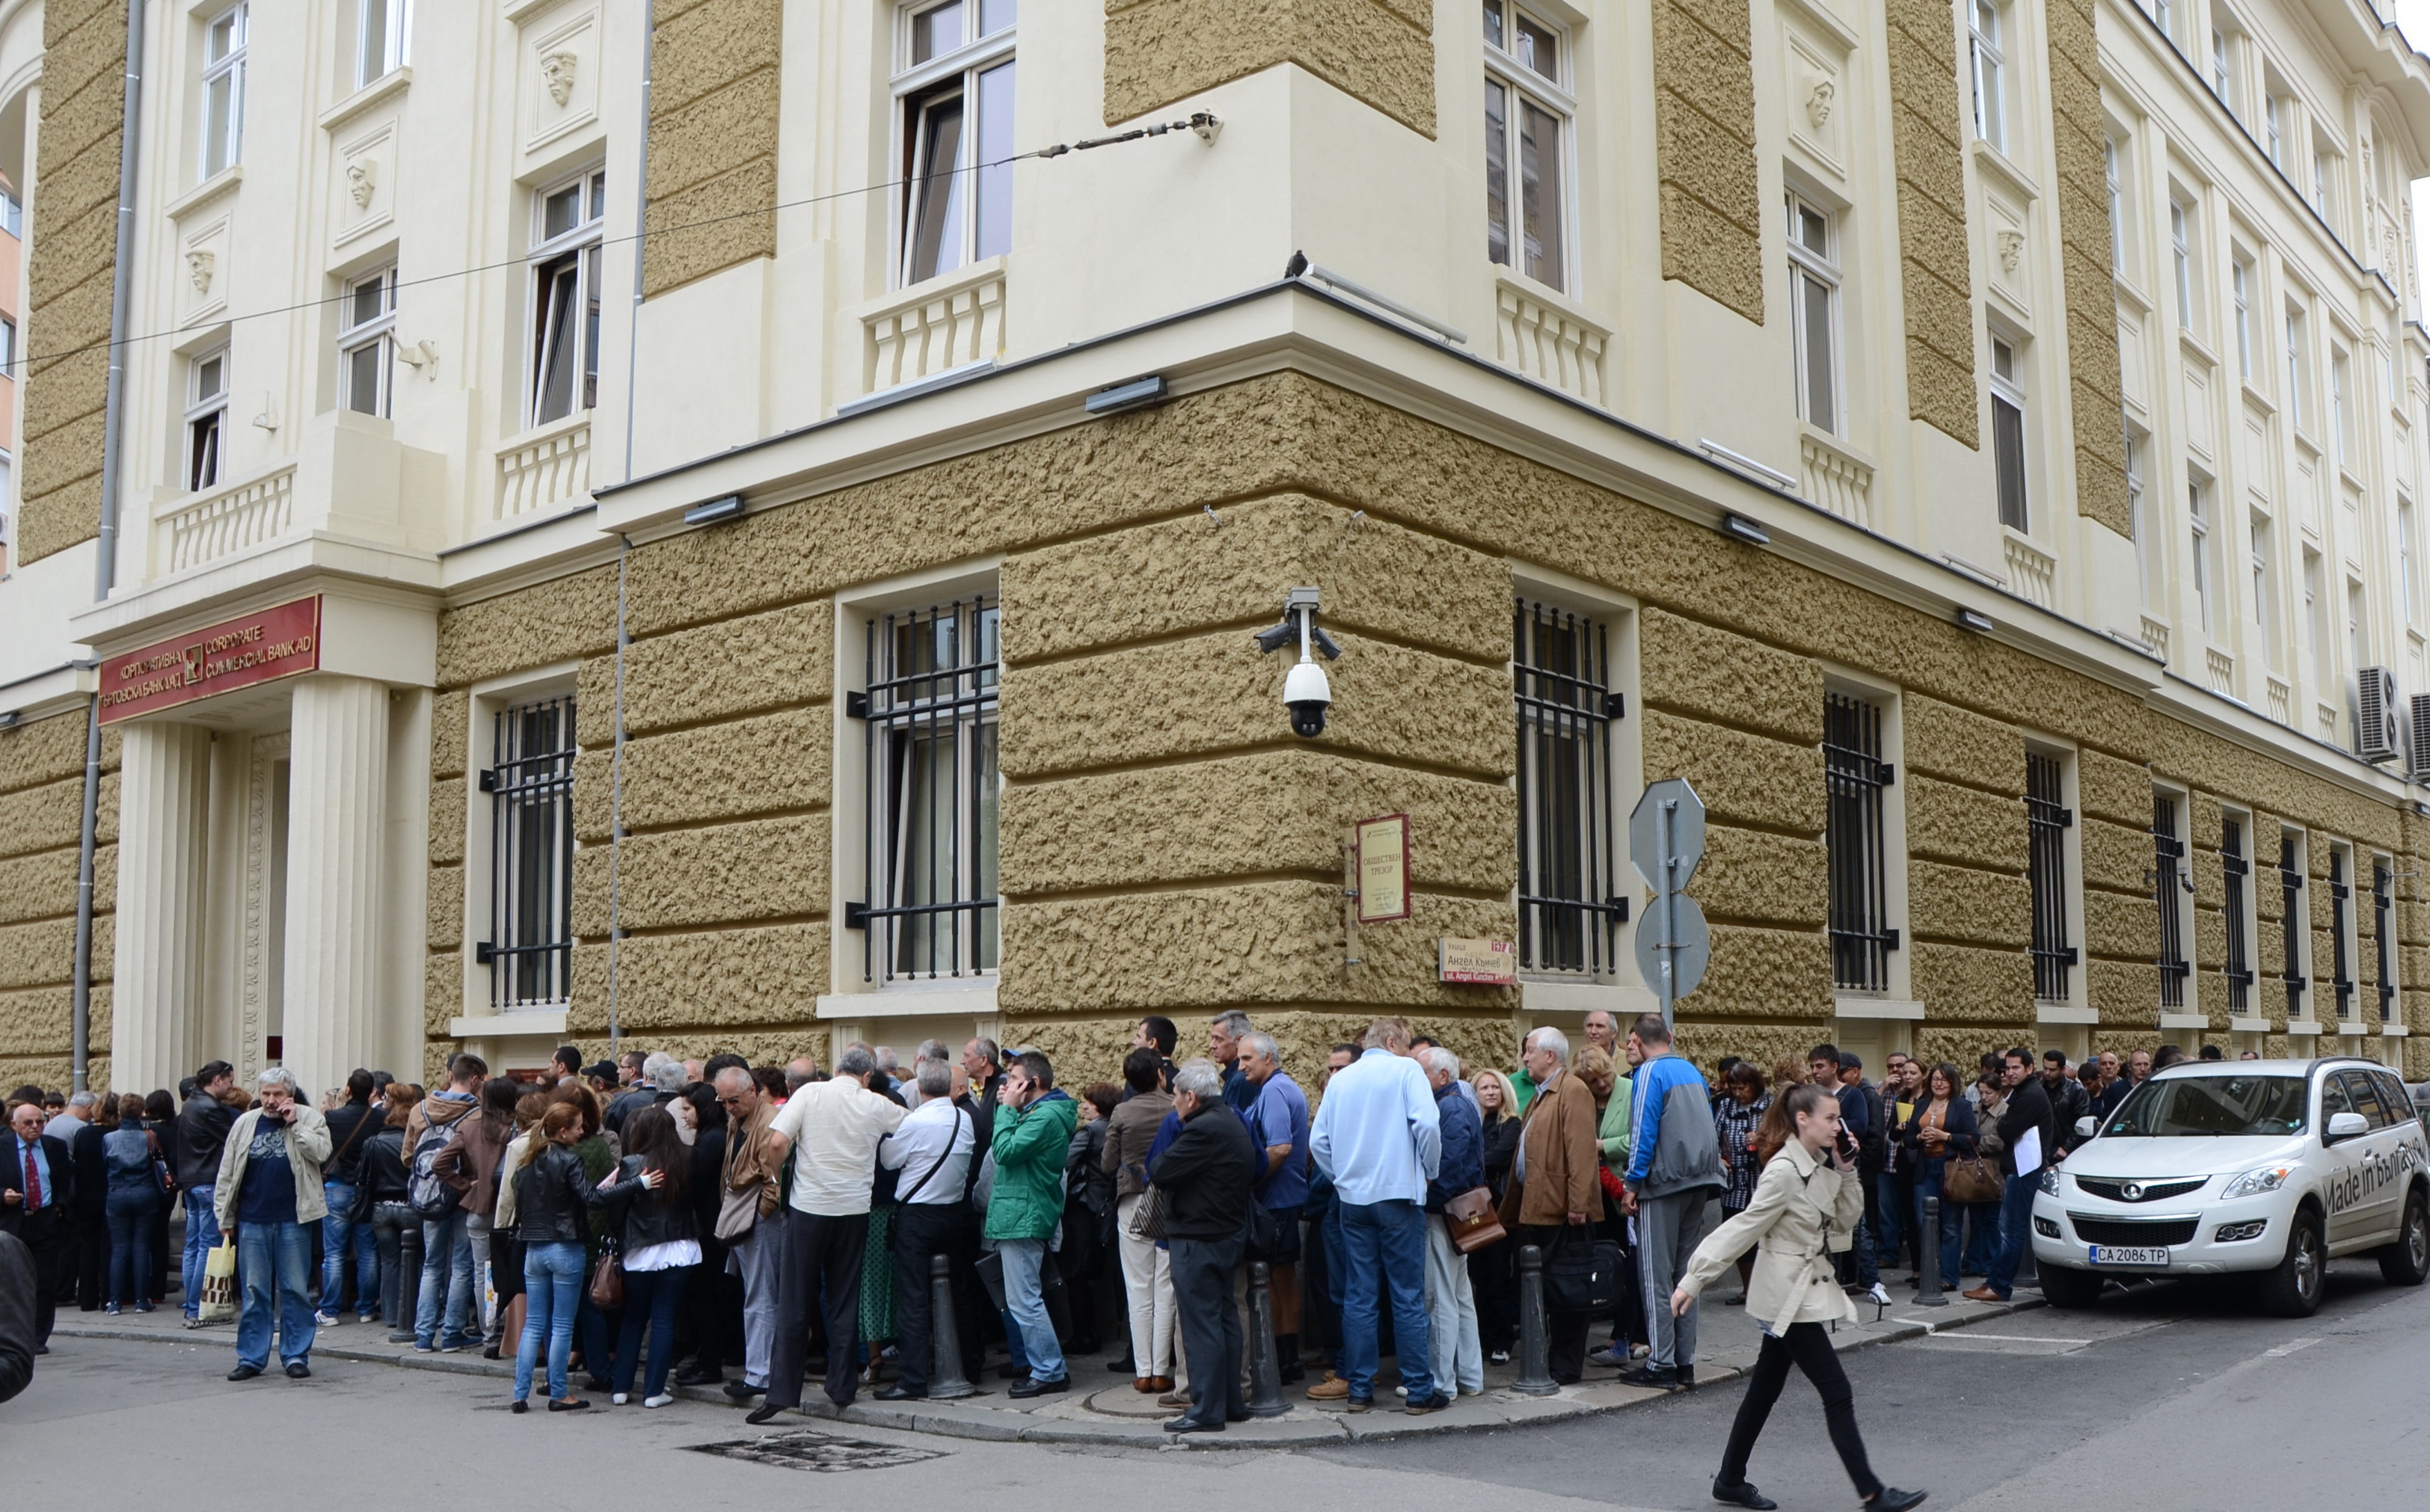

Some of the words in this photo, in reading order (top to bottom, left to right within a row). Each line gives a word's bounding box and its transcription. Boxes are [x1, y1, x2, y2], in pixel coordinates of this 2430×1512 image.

[206, 625, 262, 654] CORPORATE
[120, 650, 182, 681] КОРПОРАТИВНА
[206, 649, 266, 678] COMMERCIAL
[268, 639, 295, 660] BANK
[295, 636, 311, 654] AD
[99, 684, 142, 707] ТЪРГОВСКА
[143, 677, 169, 696] БАНКА
[1363, 852, 1401, 866] ОБЩЕСТВЕН
[1371, 865, 1393, 876] ТРЕЗОР
[1448, 956, 1473, 967] Ангел
[1475, 957, 1500, 968] Кънчев
[2323, 1165, 2360, 1220] Made
[2360, 1161, 2375, 1197] in
[2098, 1248, 2114, 1261] CA
[2117, 1249, 2147, 1262] 2086
[2149, 1249, 2166, 1262] TP
